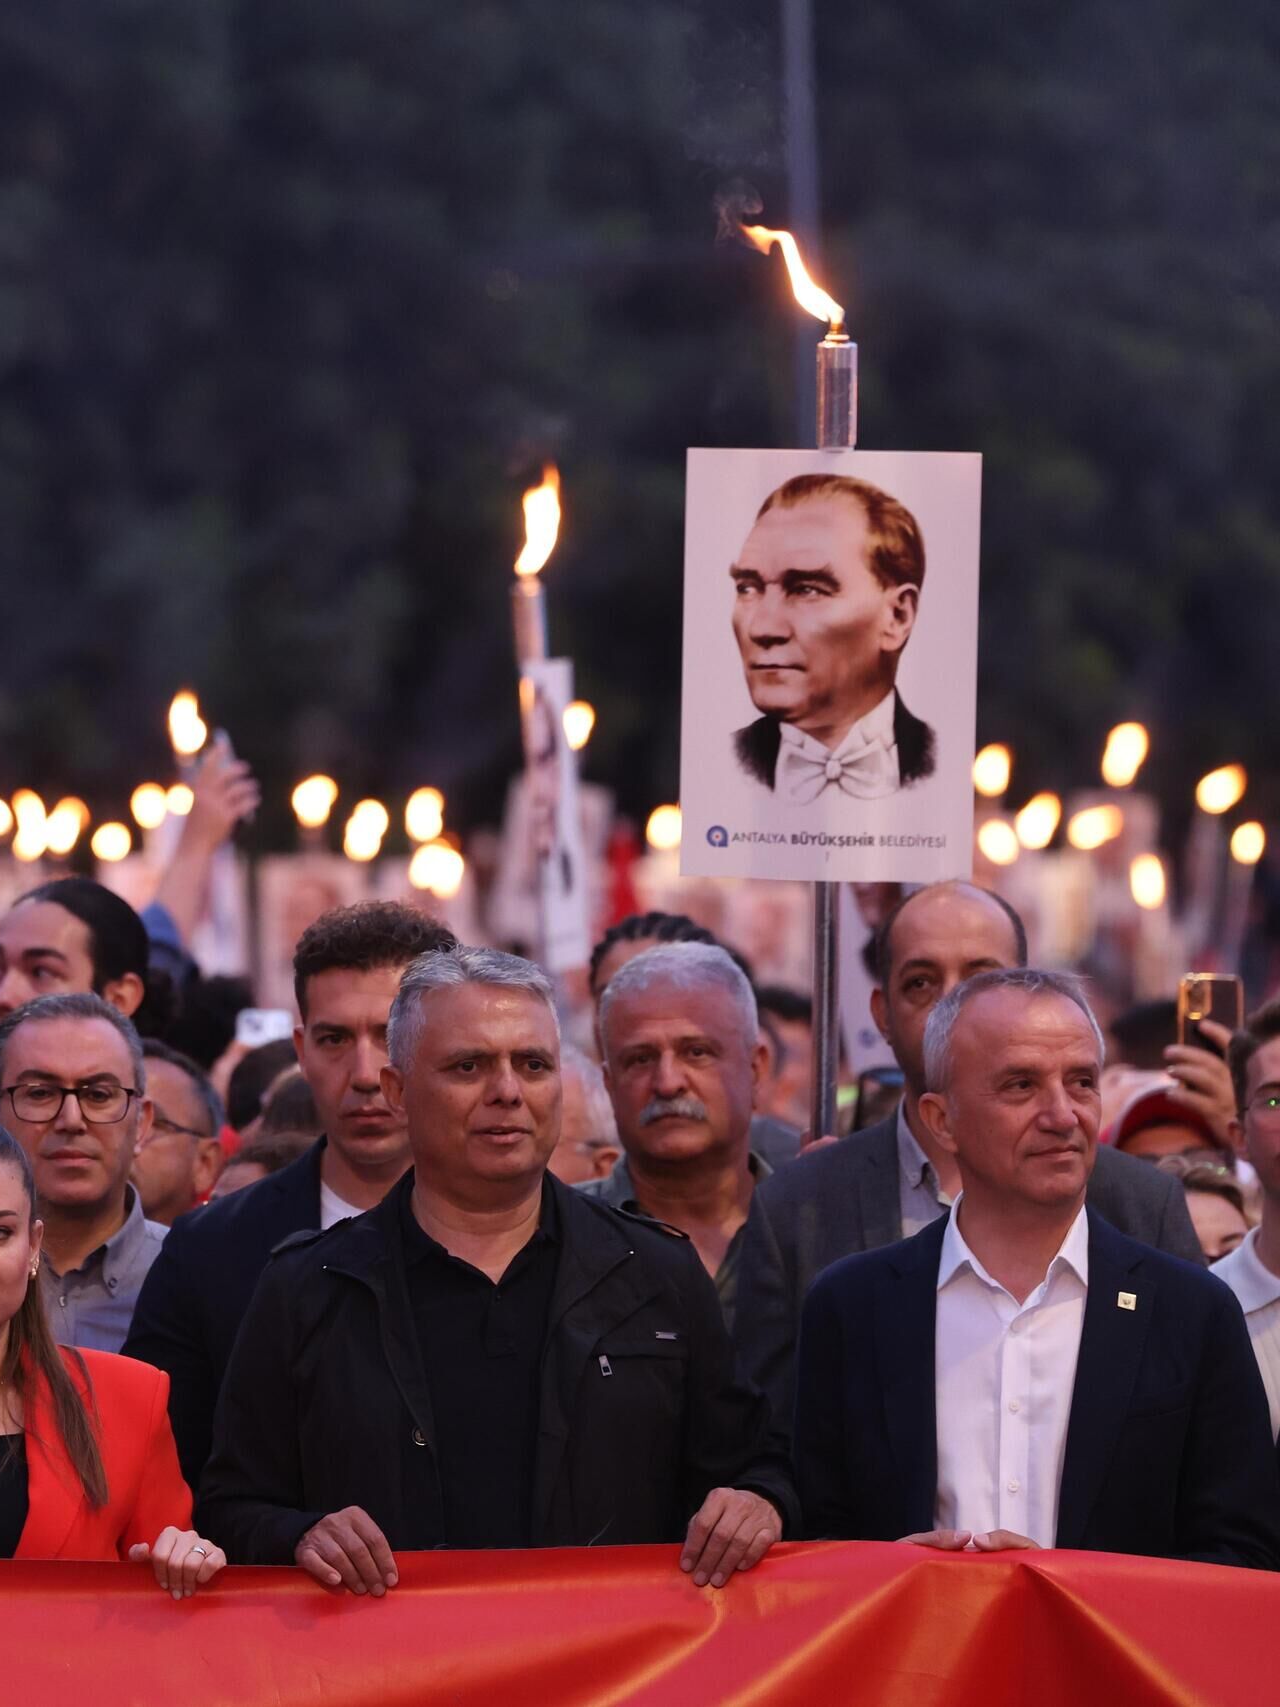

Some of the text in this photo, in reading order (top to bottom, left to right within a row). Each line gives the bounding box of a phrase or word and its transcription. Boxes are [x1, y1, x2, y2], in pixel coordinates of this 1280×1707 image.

[732, 831, 946, 848] ANTALYA BÜYÜKŞEHİR BELEDİYESİ
